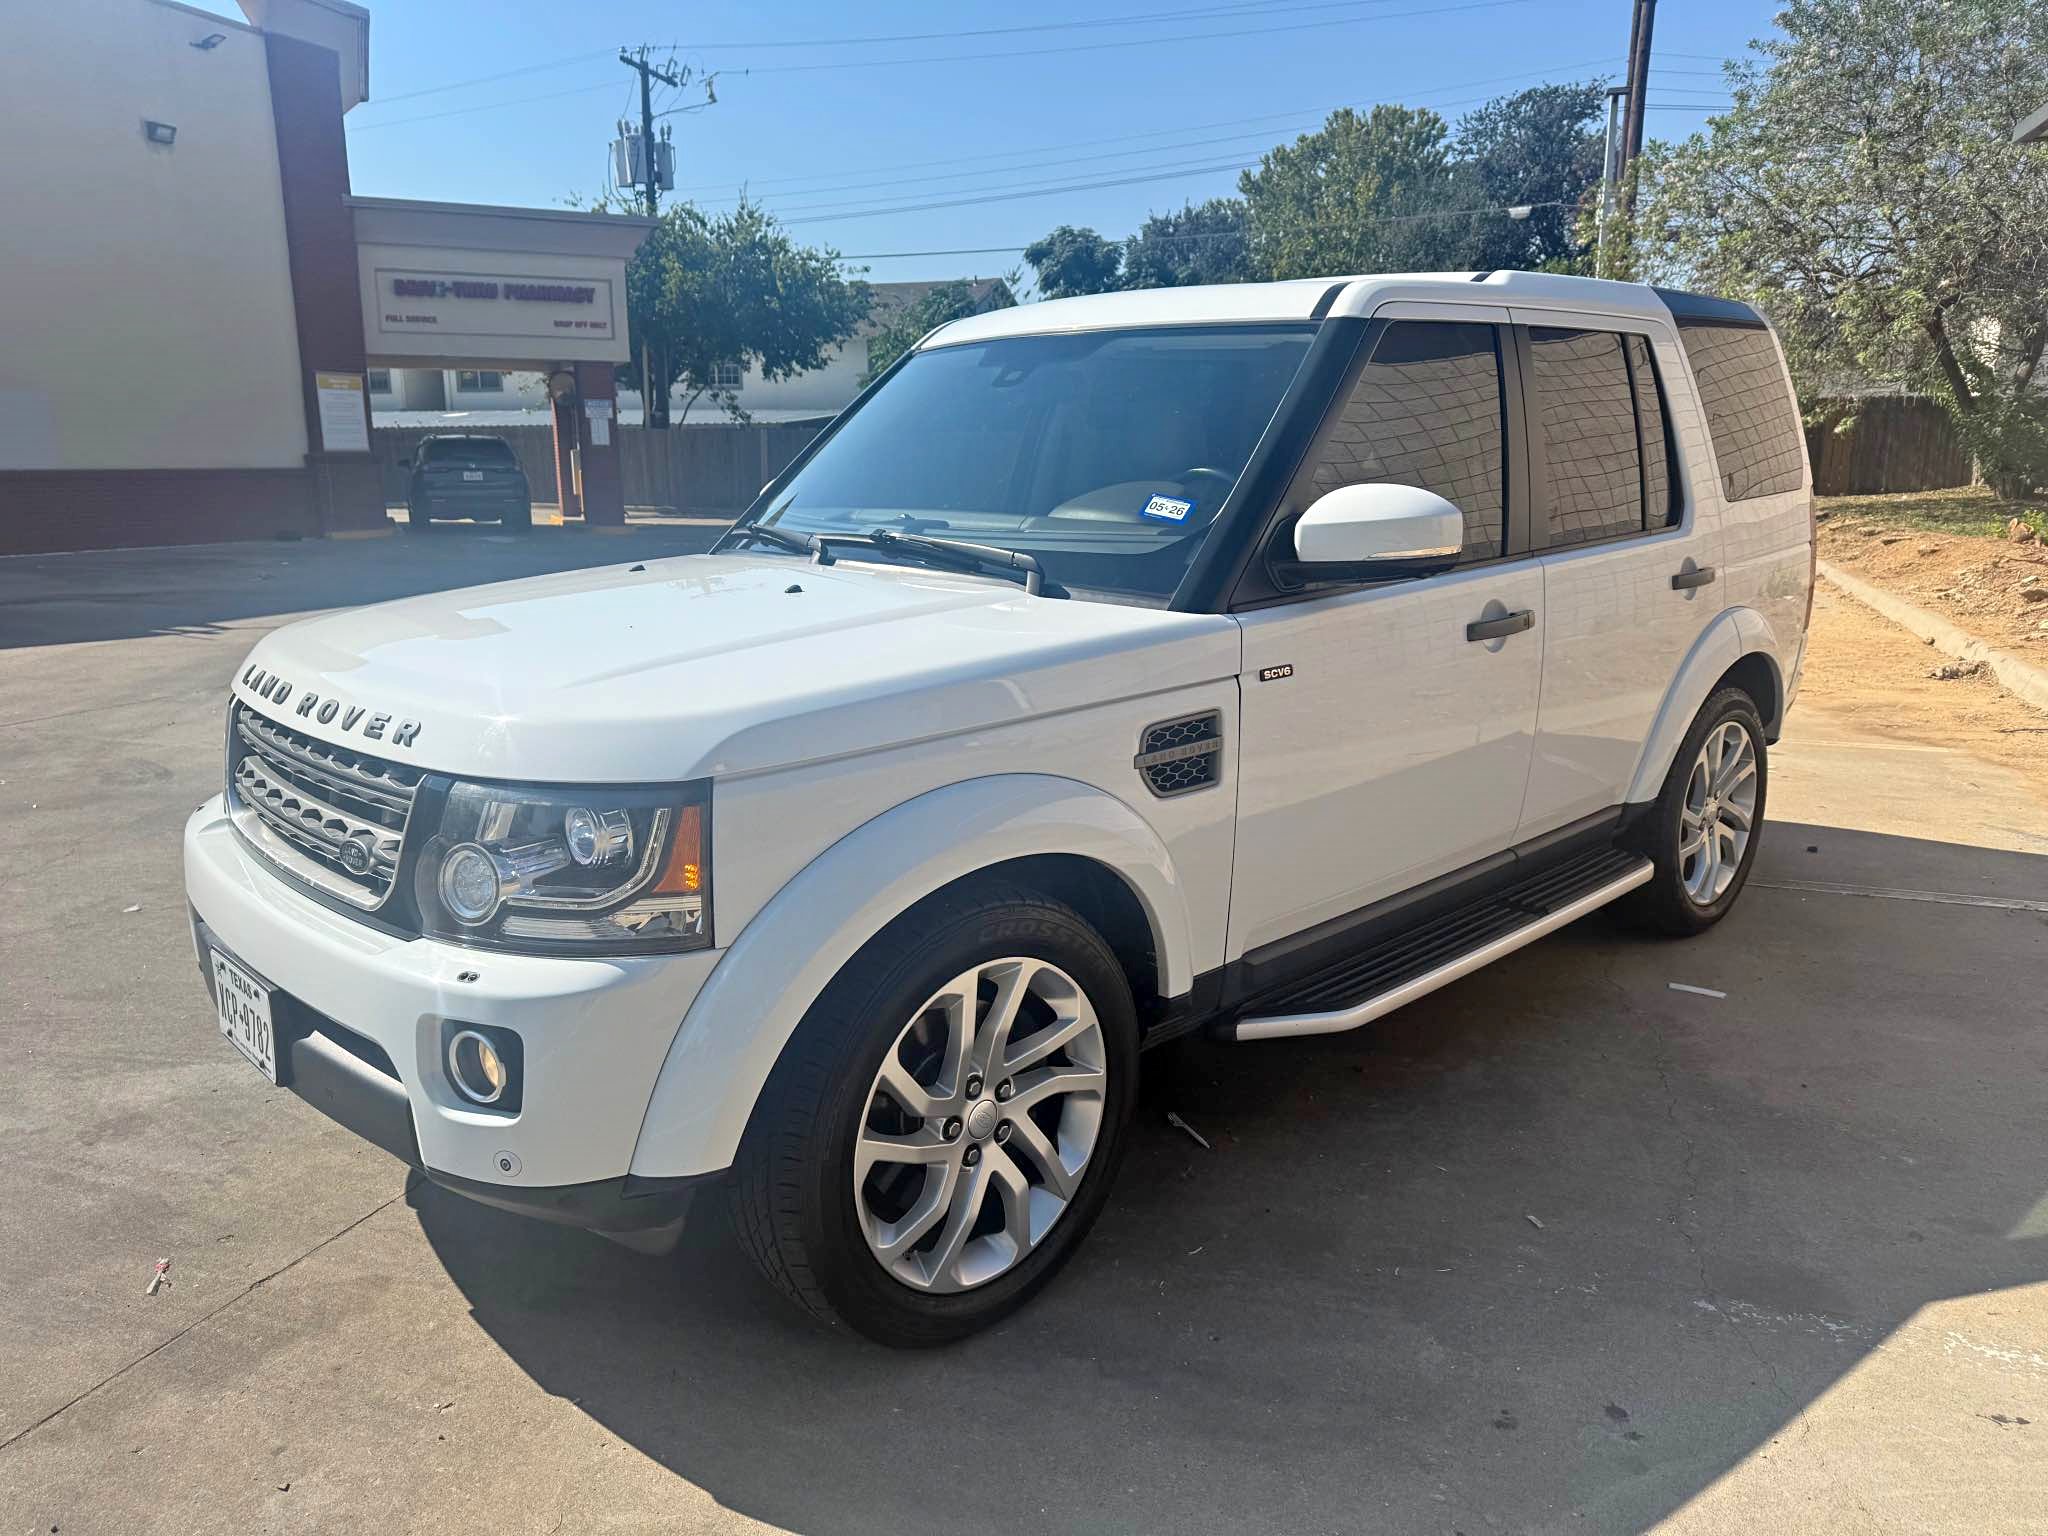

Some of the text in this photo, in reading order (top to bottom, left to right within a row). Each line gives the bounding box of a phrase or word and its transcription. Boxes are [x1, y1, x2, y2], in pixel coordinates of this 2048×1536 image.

[1263, 666, 1292, 680] SCV6
[241, 663, 422, 748] LAND ROVER
[228, 967, 253, 1000] TEXAS
